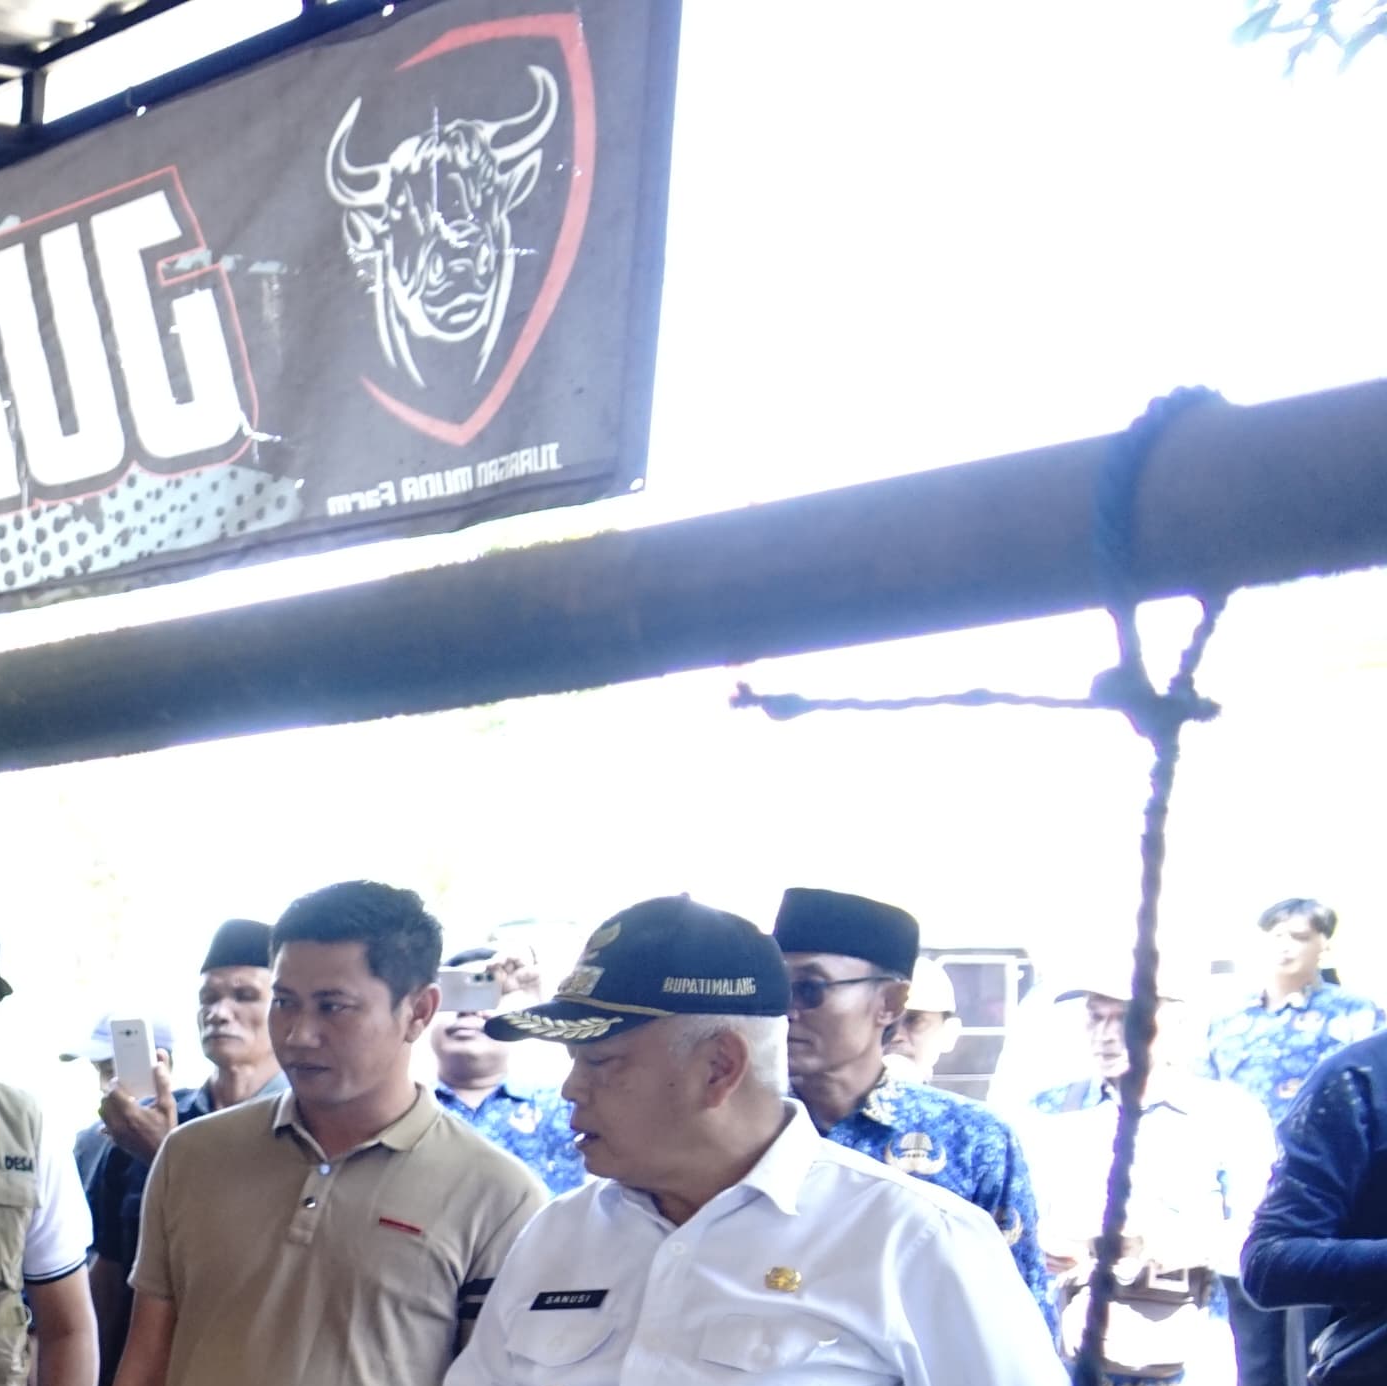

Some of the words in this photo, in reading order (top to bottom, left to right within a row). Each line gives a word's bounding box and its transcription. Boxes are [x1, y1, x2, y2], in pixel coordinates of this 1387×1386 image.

[663, 976, 711, 994] BUPATI
[712, 977, 757, 996] MALANG
[4, 1155, 34, 1173] DESA
[545, 1293, 592, 1305] SANUSI
